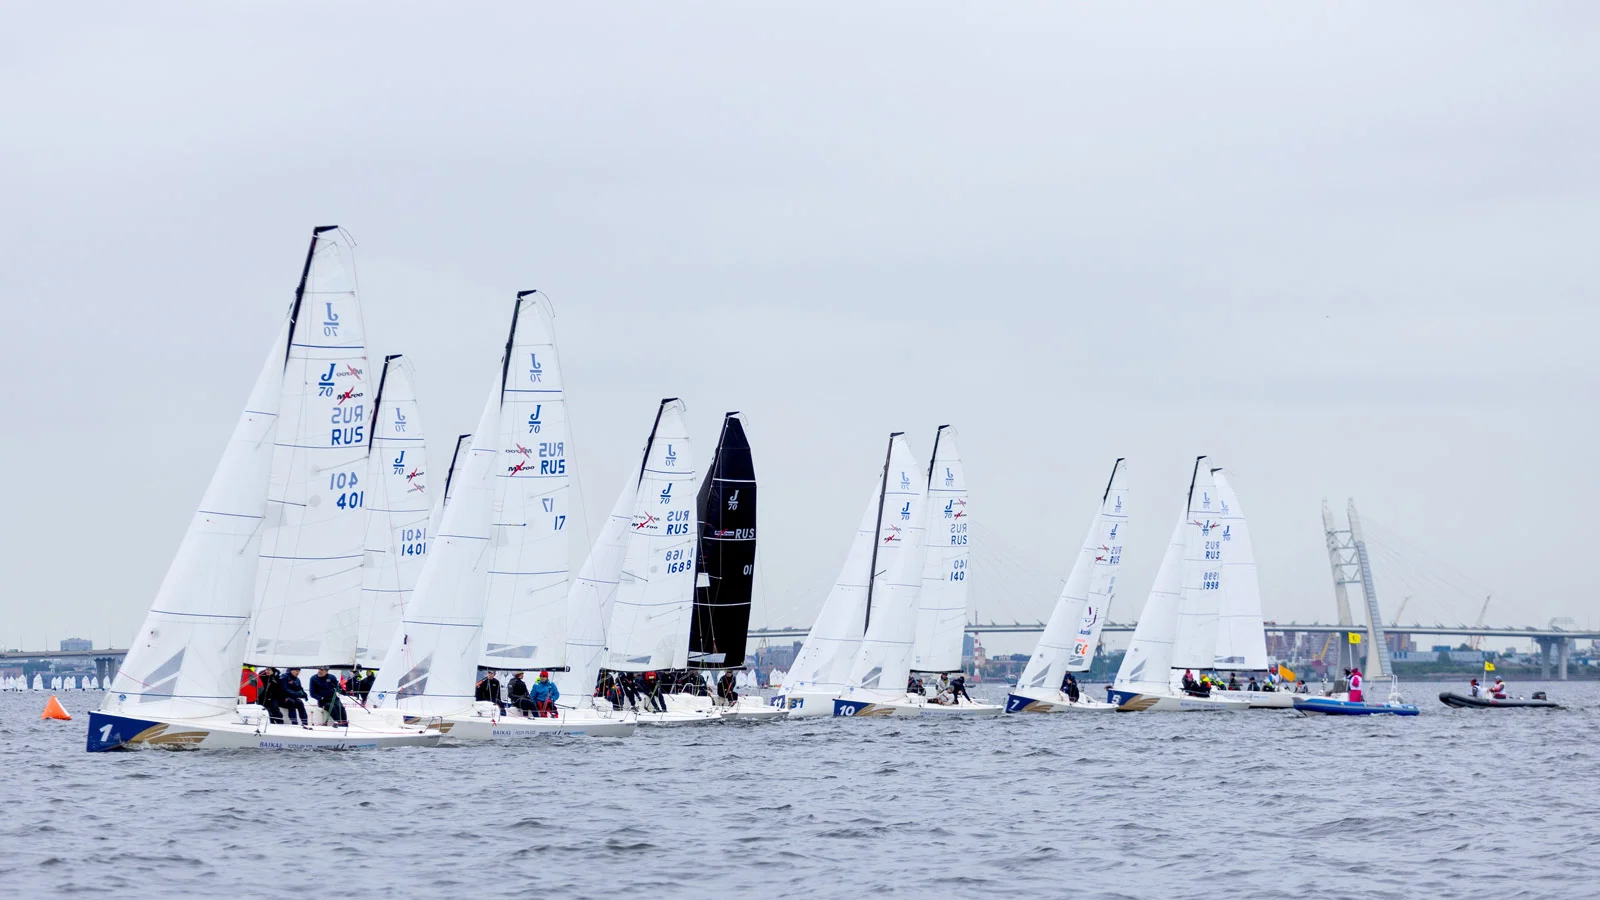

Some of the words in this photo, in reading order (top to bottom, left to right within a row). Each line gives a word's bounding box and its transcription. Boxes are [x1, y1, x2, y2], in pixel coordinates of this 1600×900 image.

[321, 364, 336, 381] J
[319, 387, 333, 397] 70
[530, 405, 541, 420] J
[528, 425, 540, 433] 70
[332, 426, 363, 445] RUS
[393, 467, 404, 475] 70
[541, 459, 565, 474] RUS
[337, 491, 364, 510] 401
[730, 490, 739, 501] J
[554, 516, 565, 530] 17
[667, 524, 688, 535] RUS
[735, 528, 754, 539] RUS
[952, 535, 967, 545] RUS
[402, 542, 426, 556] 1401
[1206, 551, 1220, 559] RUS
[667, 560, 692, 574] 1688
[950, 572, 964, 581] 140
[1203, 582, 1218, 590] 1998
[791, 698, 803, 708] 31
[1012, 700, 1020, 710] 7
[839, 705, 855, 715] 10
[99, 724, 113, 742] 1
